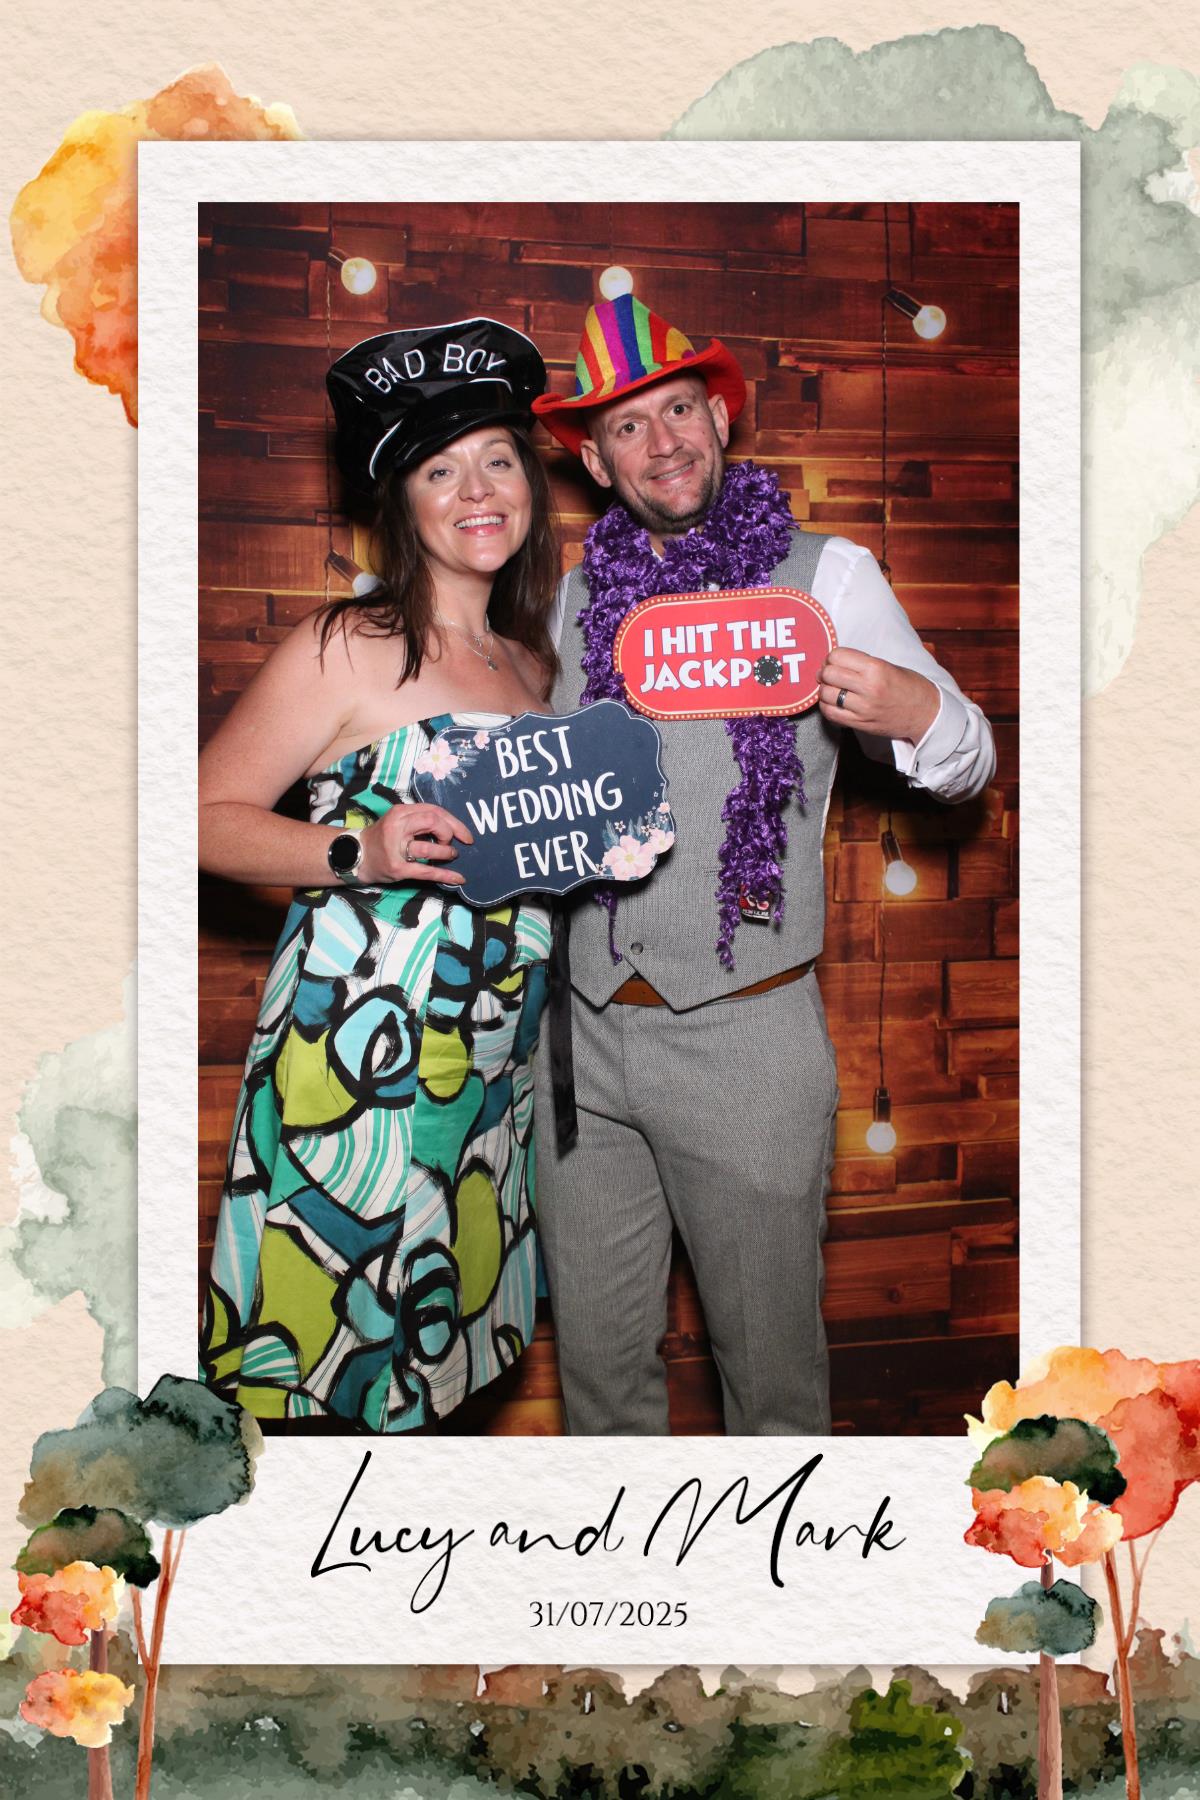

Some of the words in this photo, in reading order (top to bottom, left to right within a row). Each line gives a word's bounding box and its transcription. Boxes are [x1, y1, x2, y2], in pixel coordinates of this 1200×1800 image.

[364, 349, 425, 394] BAD
[442, 343, 507, 375] BOY
[644, 629, 654, 657] I
[661, 623, 719, 655] HIT
[726, 617, 796, 651] THE
[495, 725, 573, 779] BEST
[466, 771, 623, 835] WEDDING
[514, 830, 598, 879] EVER
